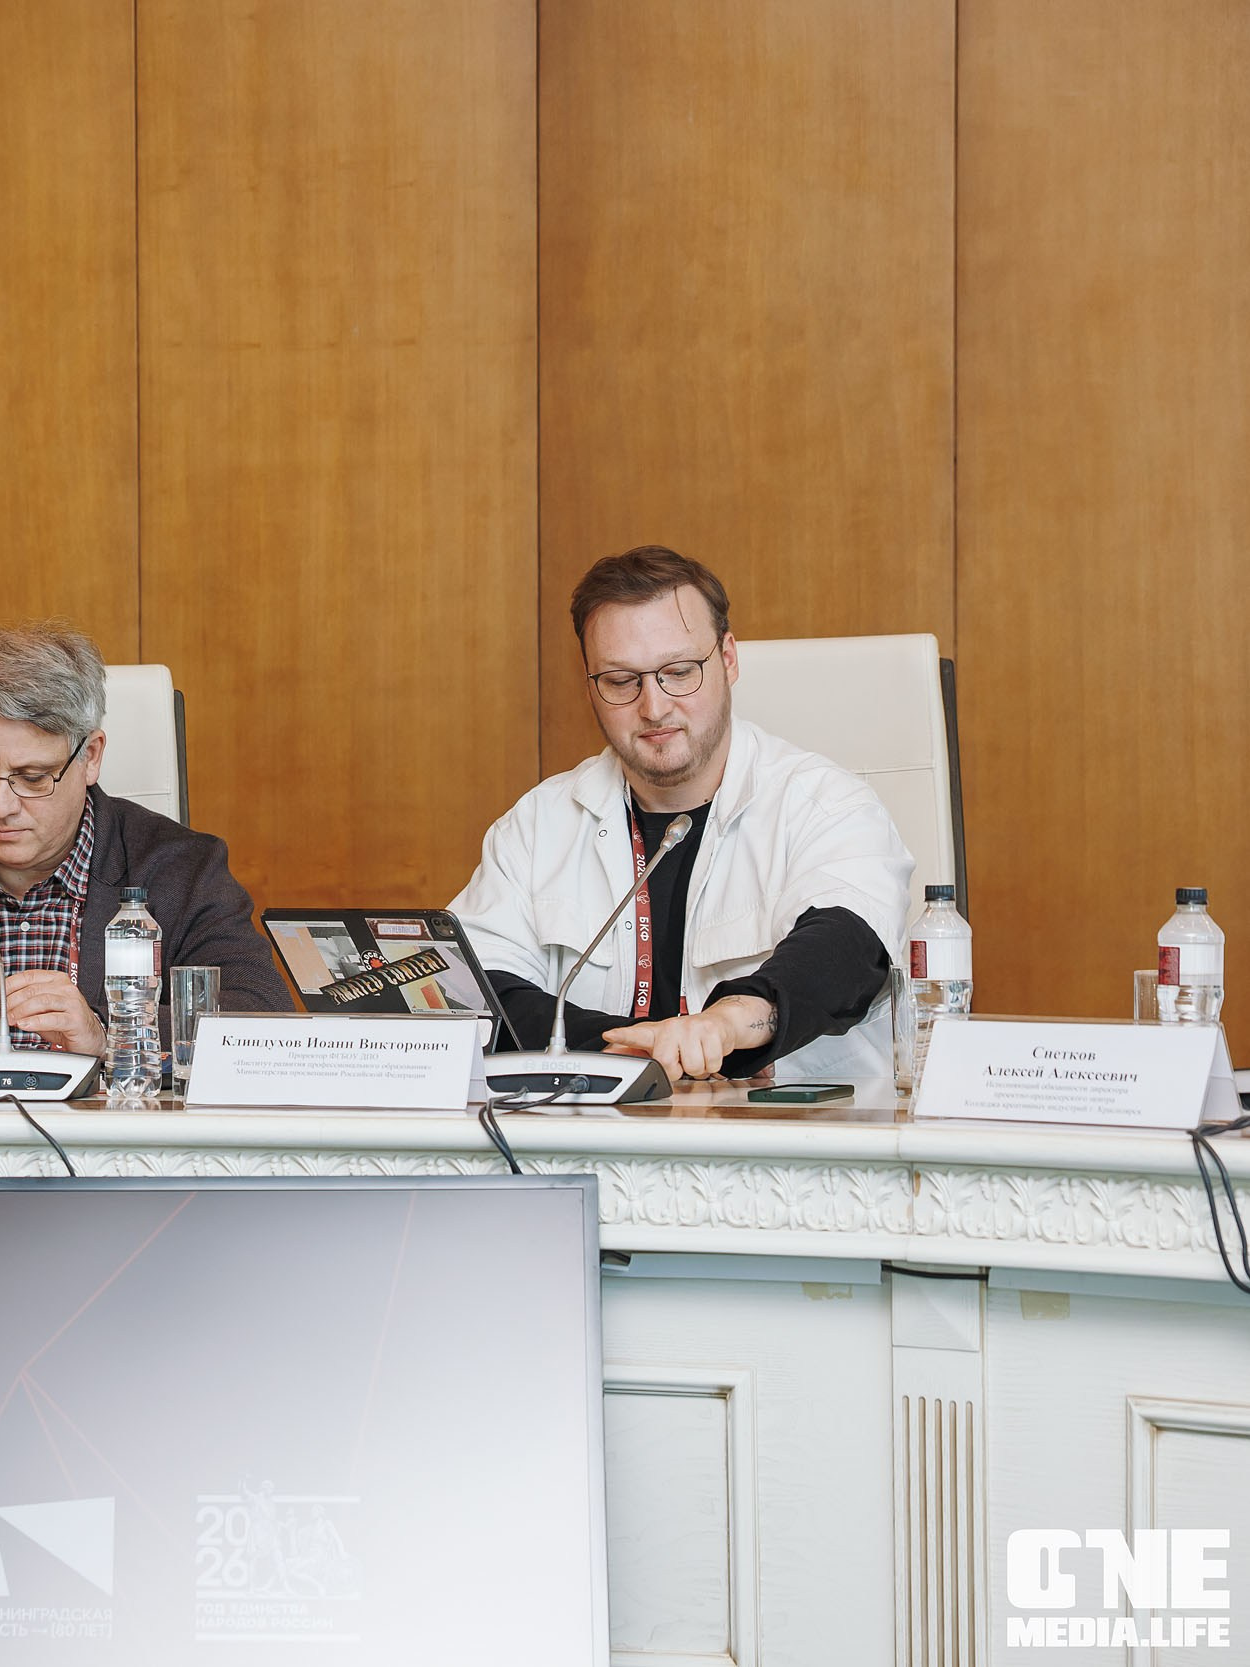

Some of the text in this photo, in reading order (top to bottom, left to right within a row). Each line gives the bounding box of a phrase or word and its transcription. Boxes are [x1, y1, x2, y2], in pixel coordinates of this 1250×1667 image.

[639, 916, 649, 942] БКФ
[637, 981, 650, 1007] БКФ
[221, 1035, 450, 1052] Клиндухов Иоанн Викторович
[542, 1062, 582, 1071] BOSCH
[982, 1063, 1138, 1083] Алексей Алексеевич
[2, 1078, 12, 1086] 76
[196, 1506, 250, 1546] 20
[196, 1546, 248, 1586] 26
[196, 1602, 310, 1616] ГОД ЕДИНСТВА
[196, 1616, 335, 1630] НАРОДОВ РОССИИ
